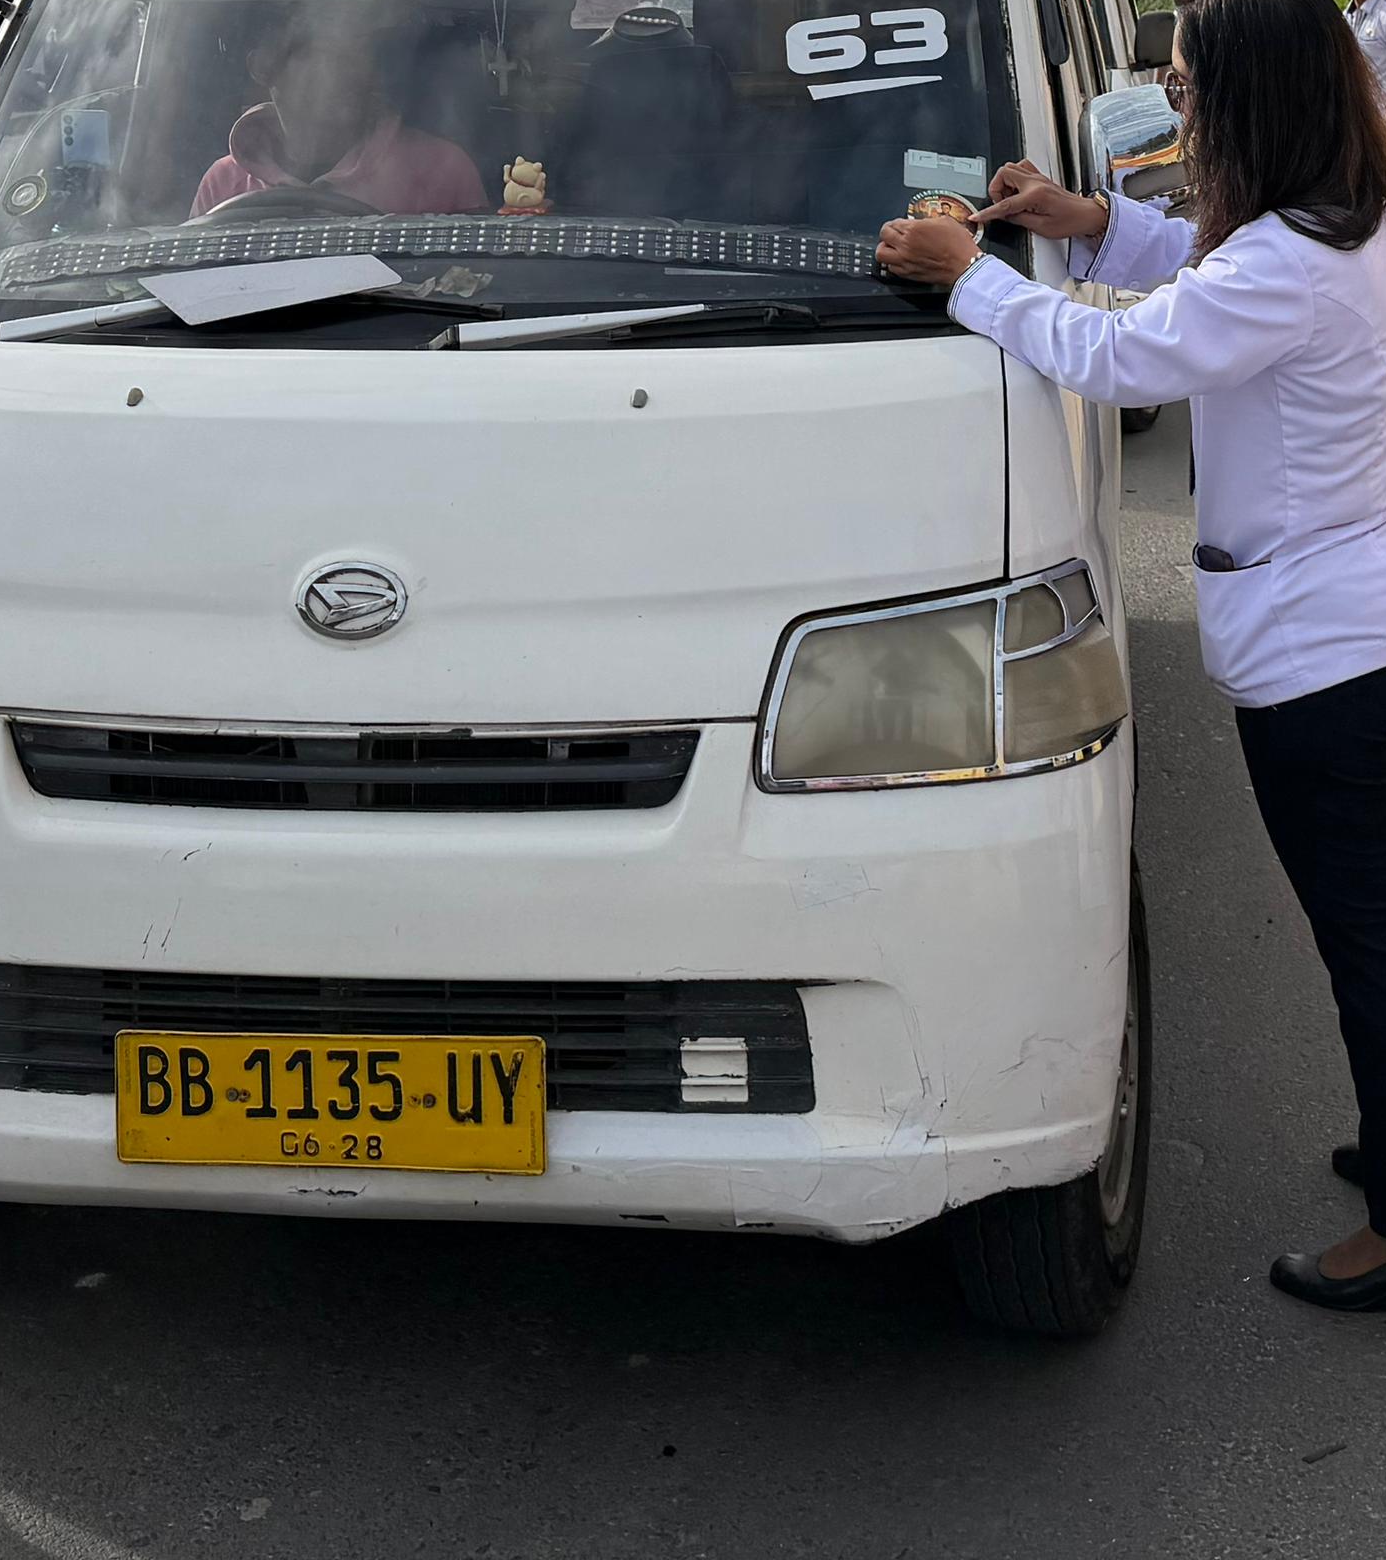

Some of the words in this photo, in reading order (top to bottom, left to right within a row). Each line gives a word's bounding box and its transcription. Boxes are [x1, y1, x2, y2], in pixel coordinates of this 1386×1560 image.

[785, 7, 948, 75] 63
[138, 1045, 214, 1117] BB
[243, 1048, 403, 1122] 1135
[446, 1050, 525, 1125] UY
[341, 1134, 383, 1160] 28
